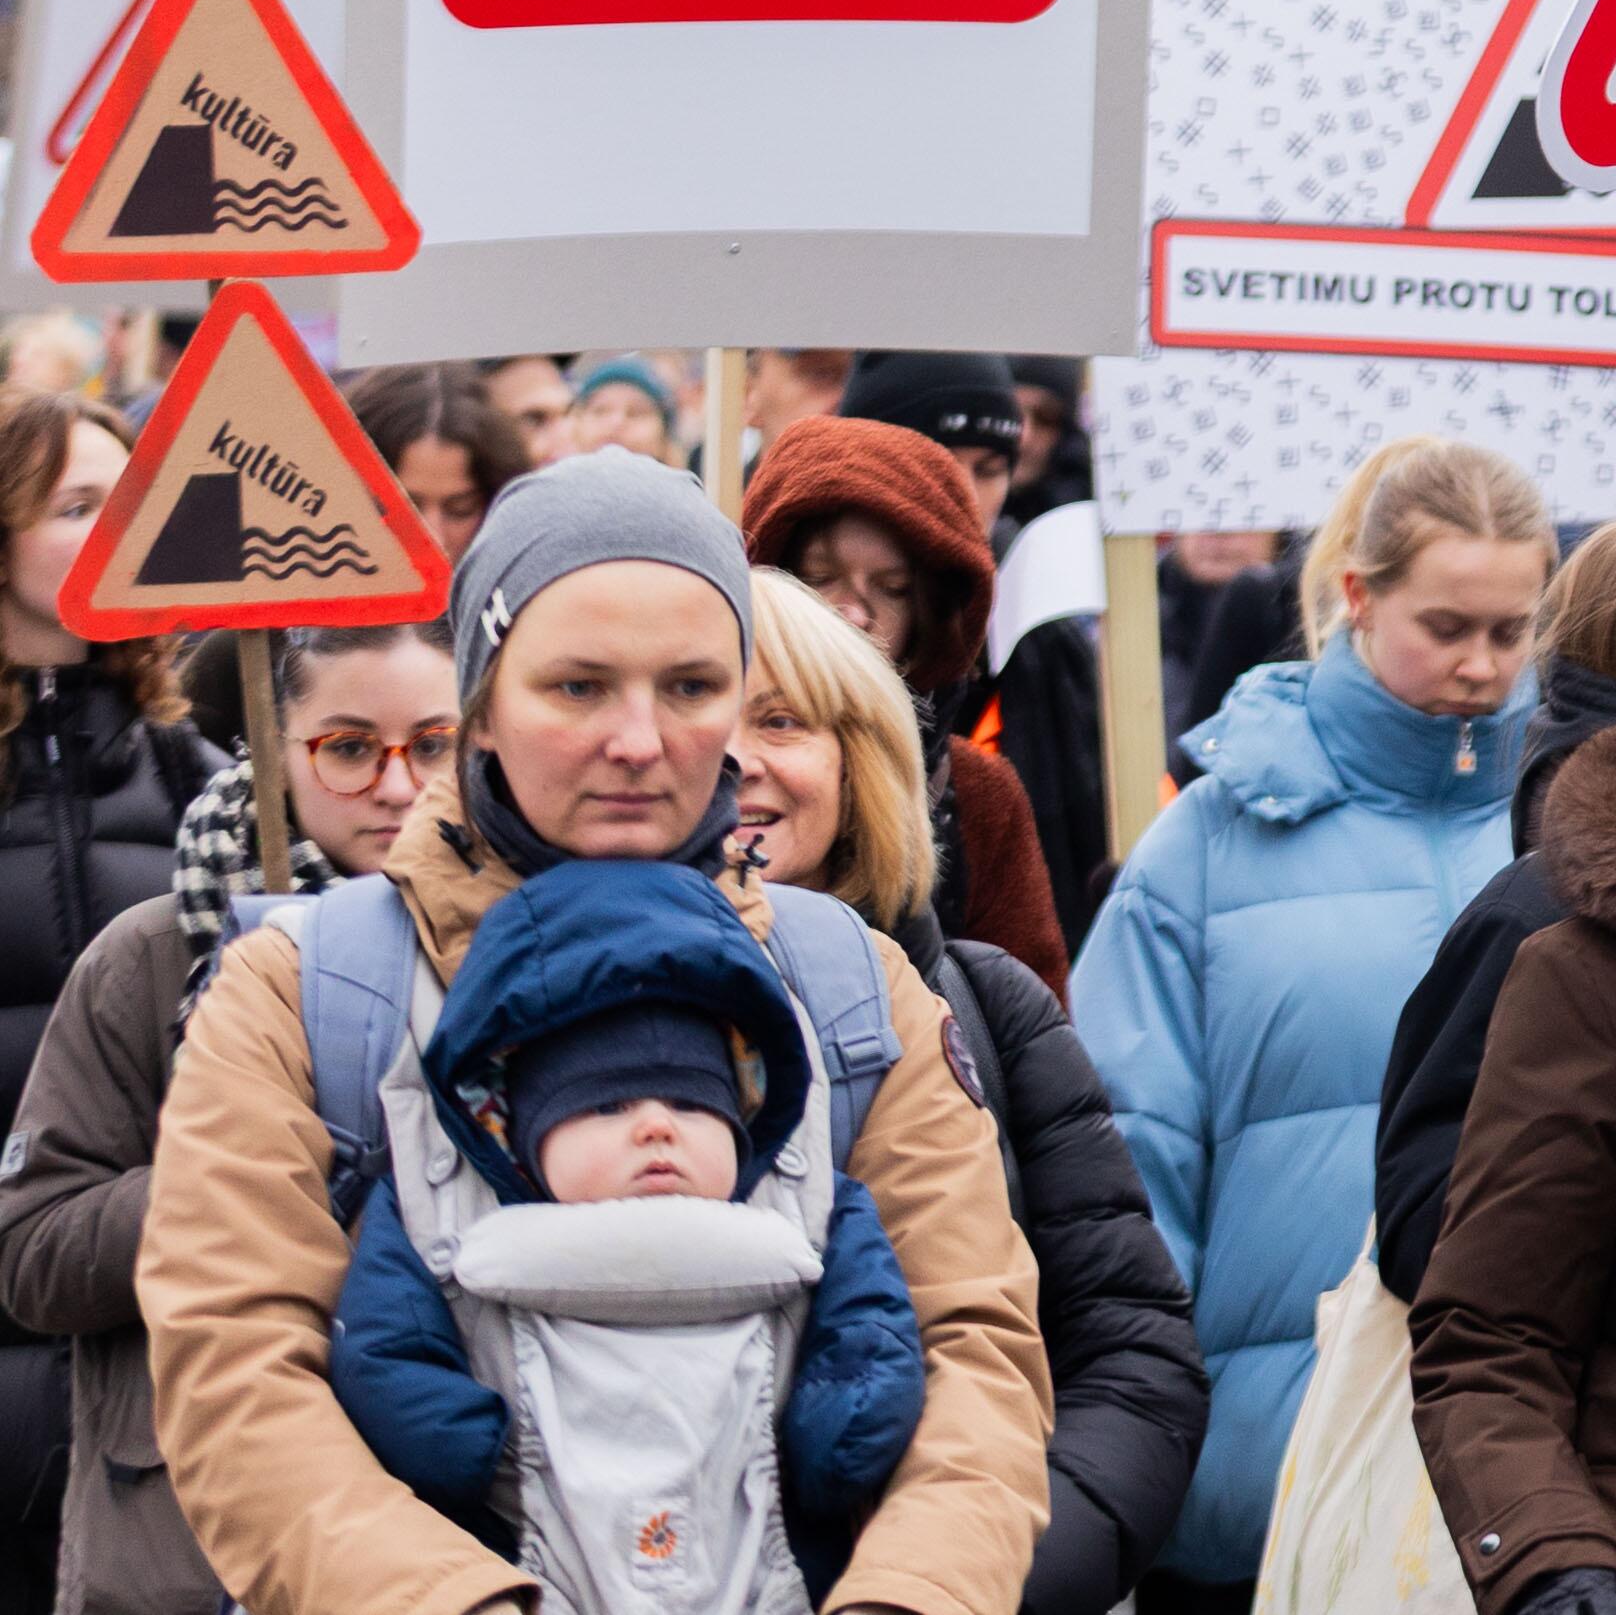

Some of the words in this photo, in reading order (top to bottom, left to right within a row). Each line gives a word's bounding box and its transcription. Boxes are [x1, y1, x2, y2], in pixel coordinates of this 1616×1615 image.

[180, 71, 298, 171] kultūra
[1183, 266, 1377, 305] SVETIMU
[1394, 278, 1532, 313] PROTU
[209, 420, 328, 518] kultūra
